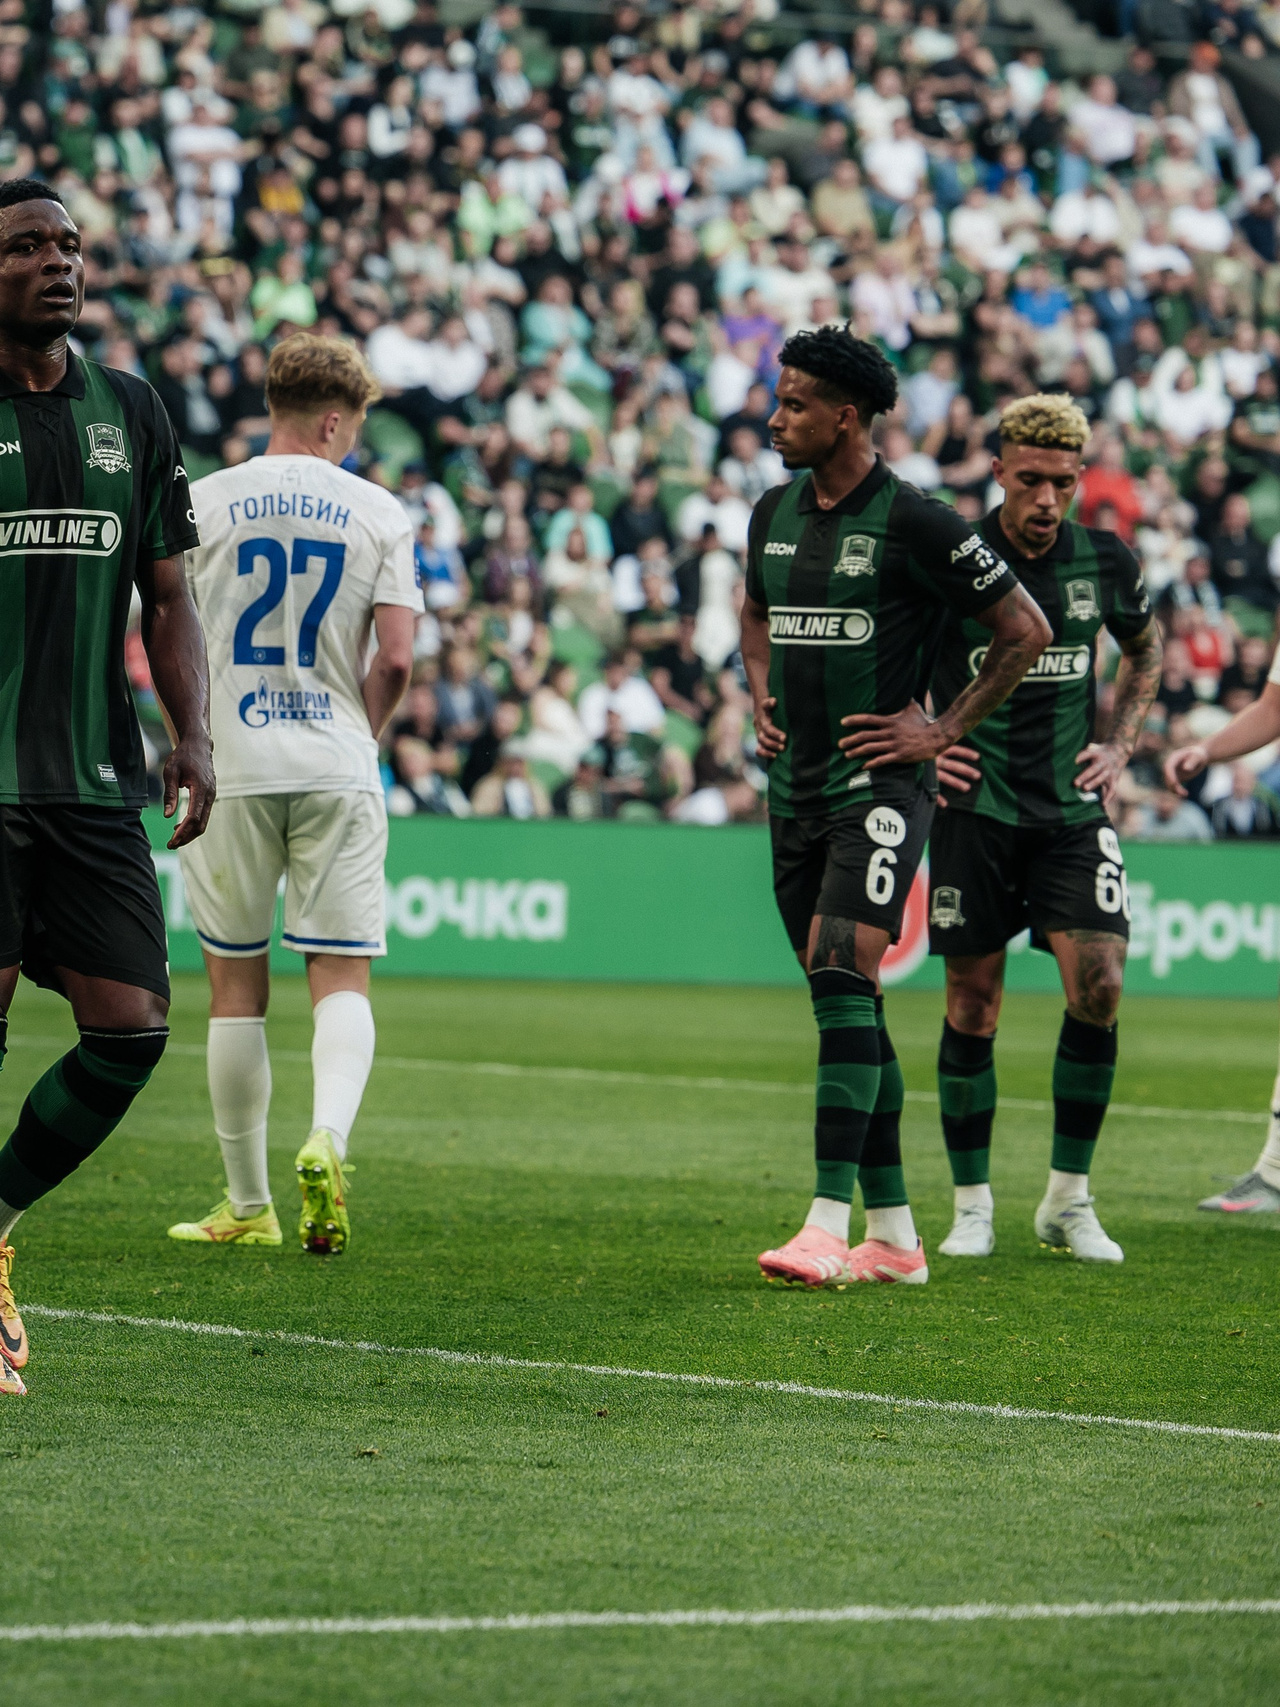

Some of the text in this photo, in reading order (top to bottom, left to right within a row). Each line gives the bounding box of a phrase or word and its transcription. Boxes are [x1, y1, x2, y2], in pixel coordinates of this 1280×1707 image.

[228, 493, 351, 529] ГОЛЫБИН
[764, 542, 797, 556] OZON
[233, 537, 346, 667] 27
[876, 818, 898, 835] hh
[865, 847, 897, 906] 6
